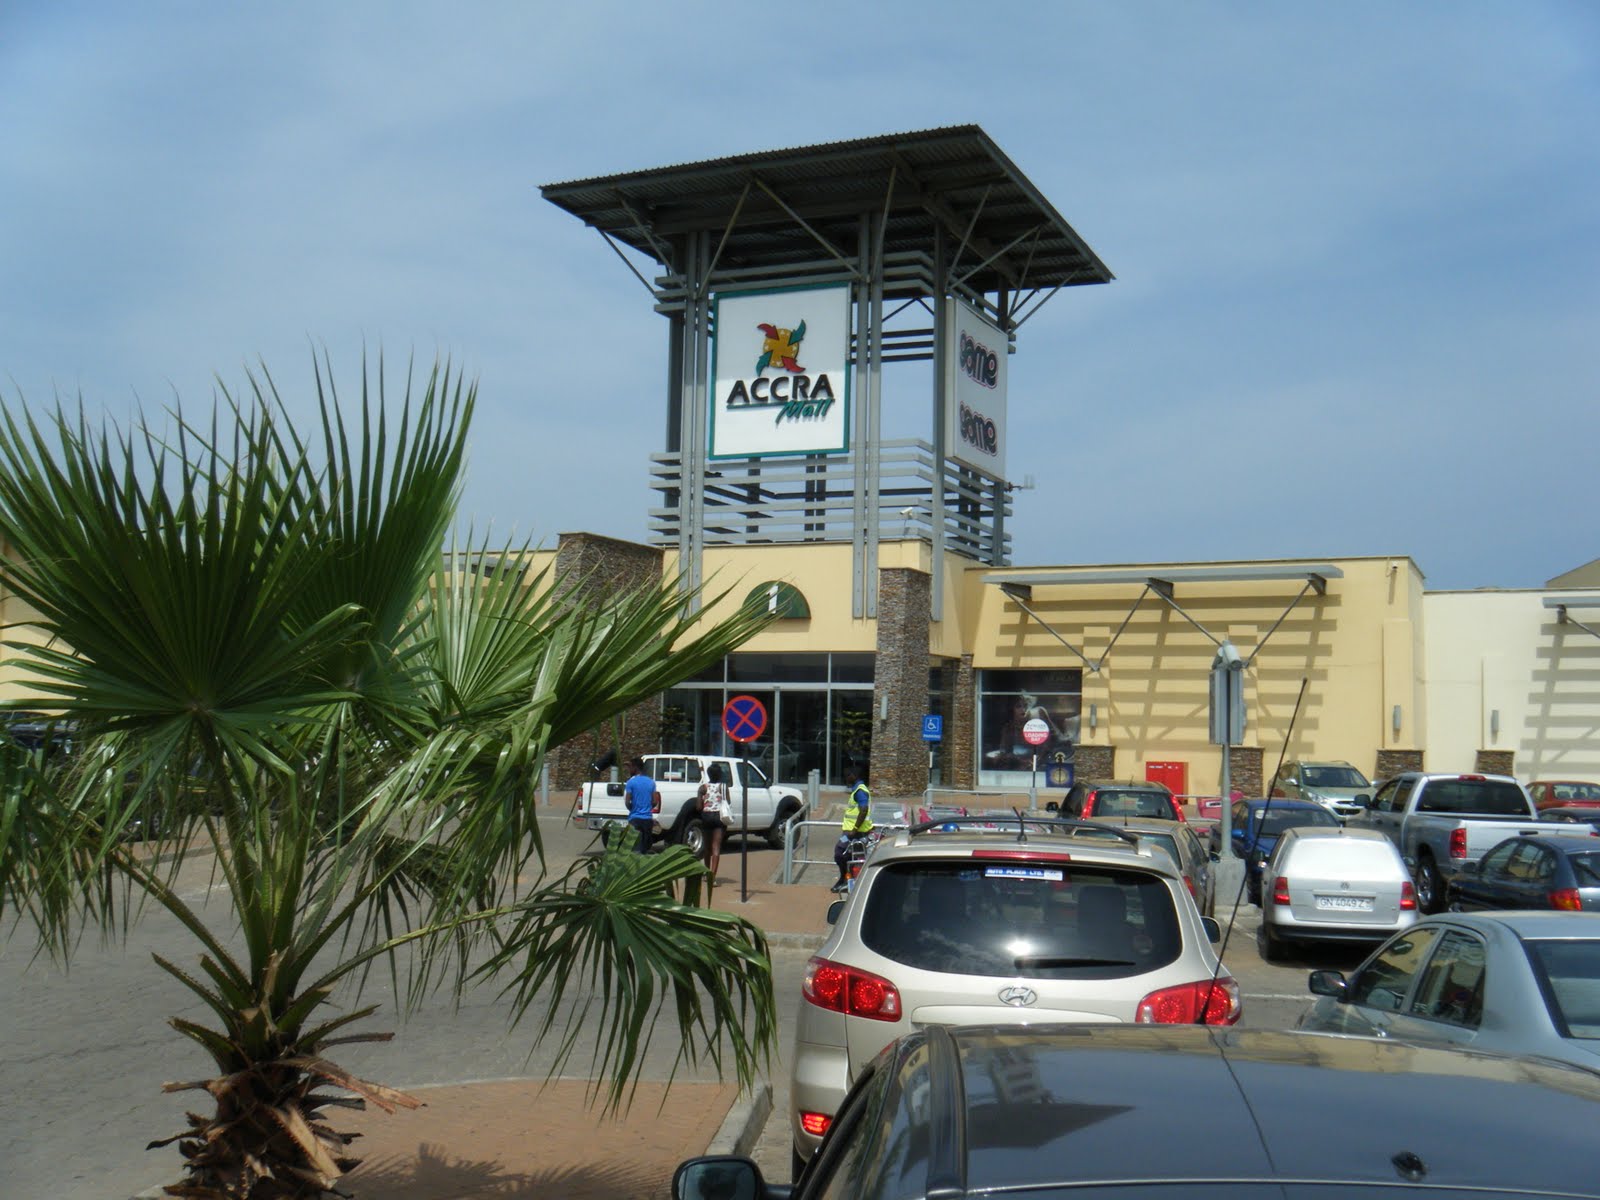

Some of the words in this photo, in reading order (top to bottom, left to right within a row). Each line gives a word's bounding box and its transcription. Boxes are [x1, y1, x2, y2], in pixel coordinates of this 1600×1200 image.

[727, 374, 834, 404] ACCRA
[775, 400, 833, 425] Mall
[1320, 897, 1333, 907] GN
[1335, 898, 1356, 907] 4049
